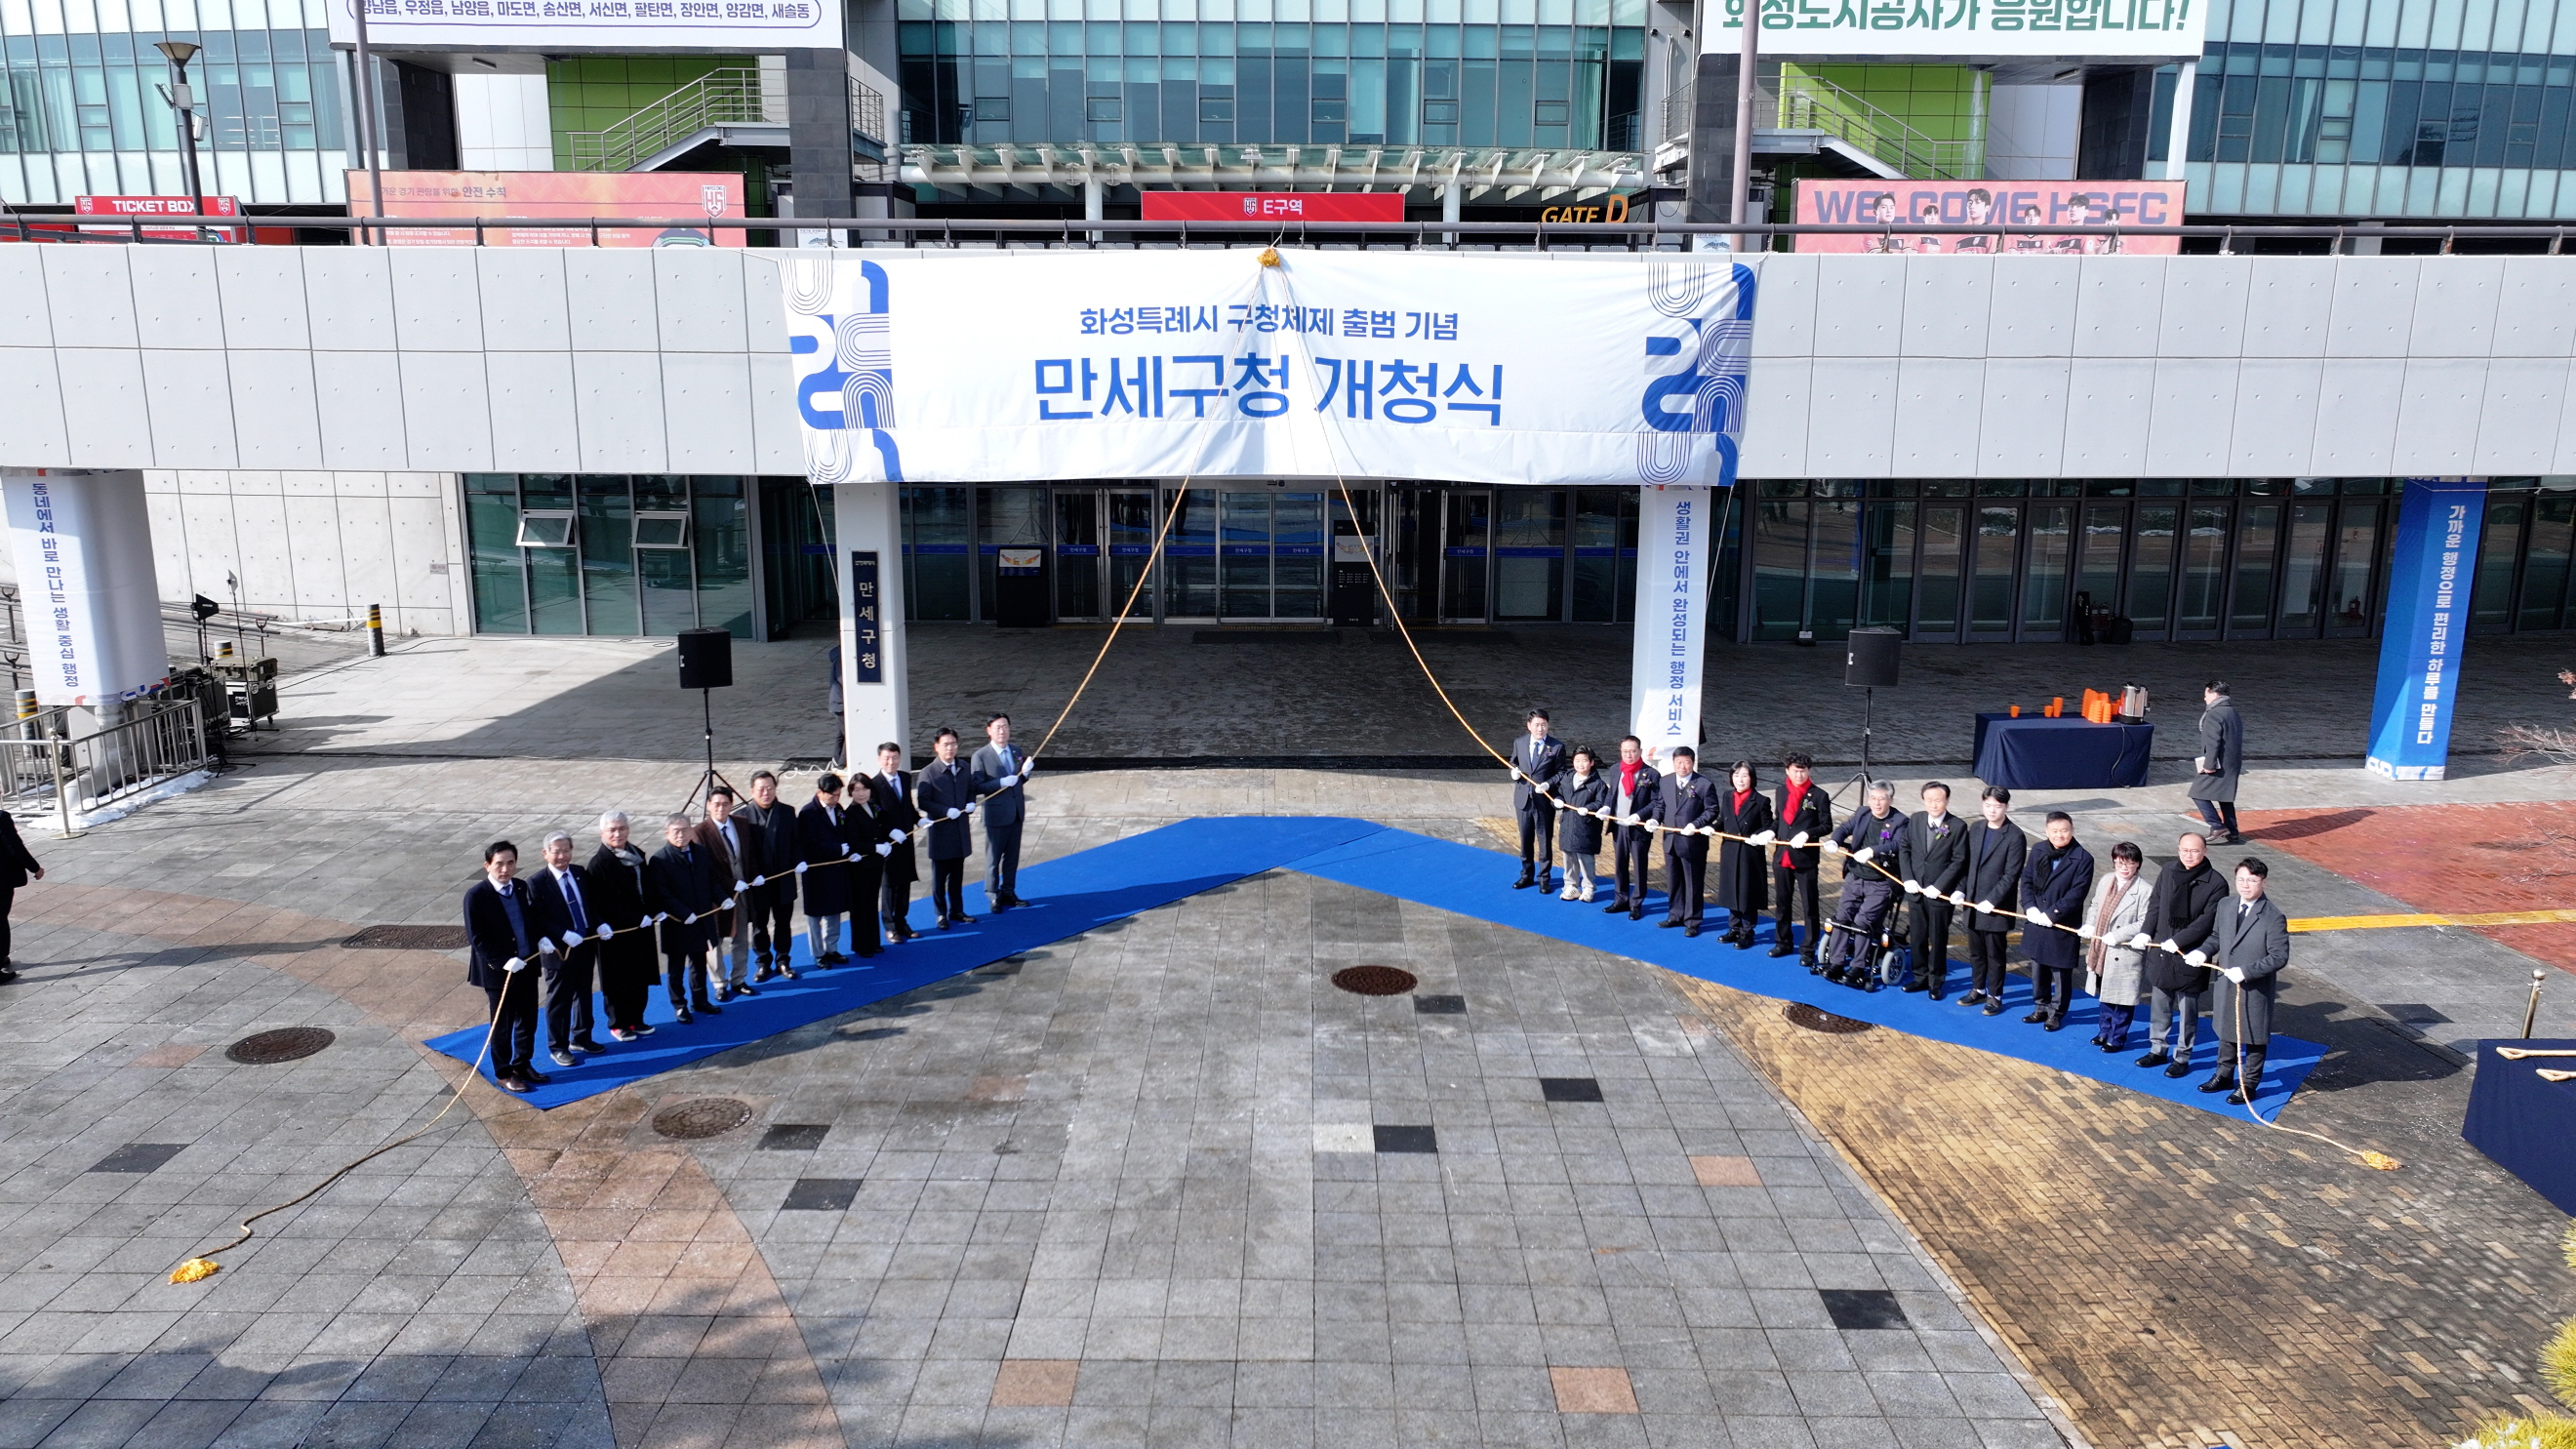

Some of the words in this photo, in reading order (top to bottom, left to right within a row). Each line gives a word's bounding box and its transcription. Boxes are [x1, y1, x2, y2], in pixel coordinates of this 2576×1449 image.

[405, 0, 448, 17] 우정읍,
[451, 0, 494, 18] 남양읍,
[498, 1, 540, 19] 마도면,
[543, 1, 585, 19] 송산면,
[589, 2, 631, 19] 서신면,
[634, 2, 677, 19] 팔탄면,
[680, 2, 722, 19] 장안면,
[726, 3, 768, 20] 양감면,
[772, 3, 810, 19] 새솔동
[1991, 0, 2190, 31] 응원합니다!
[112, 200, 164, 213] TICKET
[167, 200, 195, 213] BOX
[382, 187, 396, 196] 거운
[399, 187, 415, 196] 경기
[417, 187, 440, 196] 관람을
[442, 187, 459, 197] 위한
[463, 186, 483, 198] 안전
[486, 186, 506, 198] 수칙
[1264, 199, 1303, 216] E구역
[1542, 206, 1600, 222] GATE
[1605, 194, 1629, 222] D
[2050, 191, 2168, 225] HSFC
[1079, 303, 1219, 336] 화성특례시
[1227, 303, 1334, 337] 구청체제
[1342, 307, 1396, 339] 출범
[1405, 310, 1459, 341] 기념
[1034, 352, 1290, 422] 만세구청
[1313, 356, 1504, 426] 개청식
[32, 483, 55, 534] 동네에서
[1674, 501, 1692, 545] 생활권
[2445, 504, 2466, 548] 가까운
[41, 538, 60, 563] 바로
[46, 566, 65, 603] 만나는
[1672, 549, 1690, 594] 안에서
[2435, 551, 2459, 609] 행정으로
[53, 607, 70, 631] 생활
[859, 582, 876, 669] 만세구청
[1670, 598, 1688, 657] 완성되는
[2430, 612, 2450, 655] 편리한
[58, 635, 74, 660] 중심
[61, 663, 79, 687] 행정
[1670, 661, 1685, 690] 행정
[2423, 658, 2444, 701] 하루를
[1667, 694, 1683, 736] 서비스
[2416, 703, 2437, 745] 만들다
